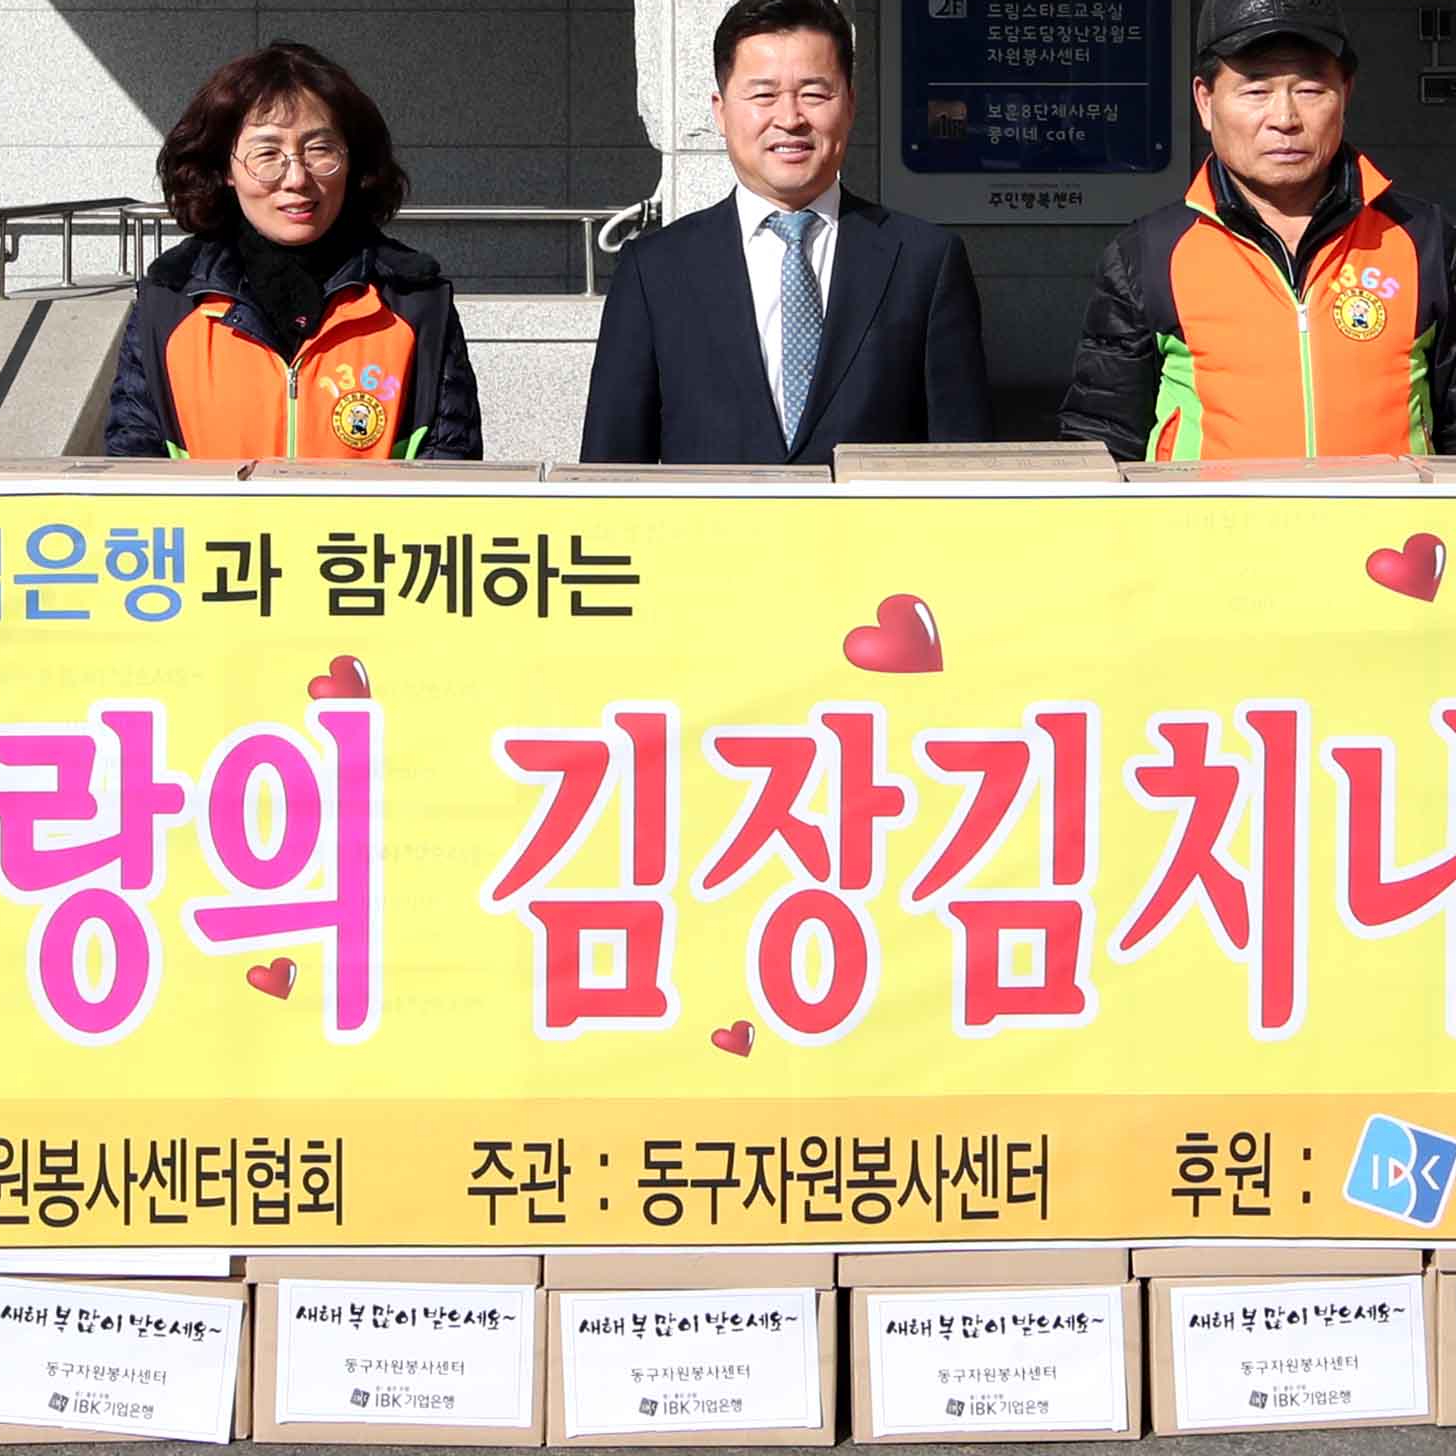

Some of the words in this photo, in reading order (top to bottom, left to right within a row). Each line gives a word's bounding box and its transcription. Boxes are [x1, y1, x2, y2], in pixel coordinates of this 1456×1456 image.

[987, 47, 1091, 66] 자원봉사센터
[1046, 127, 1087, 143] cafe
[988, 191, 1084, 209] 주민행복센터
[319, 363, 401, 401] 1365
[315, 532, 641, 622] 함께하는
[466, 1136, 570, 1228] 주관
[636, 1133, 1049, 1227] 동구자원봉사센터
[1170, 1131, 1273, 1217] 후원
[296, 1305, 341, 1324] 새해
[349, 1303, 365, 1329] 복
[373, 1305, 416, 1328] 많이
[579, 1317, 624, 1335] 새해
[632, 1314, 647, 1339] 복
[655, 1313, 698, 1336] 많이
[1189, 1312, 1234, 1329] 새해
[1242, 1308, 1256, 1332] 복
[1264, 1307, 1307, 1330] 많이
[344, 1358, 465, 1376] 동구자원봉사센터
[631, 1364, 750, 1383] 동구자원봉사센터
[1240, 1355, 1359, 1376] 동구자원봉사센터
